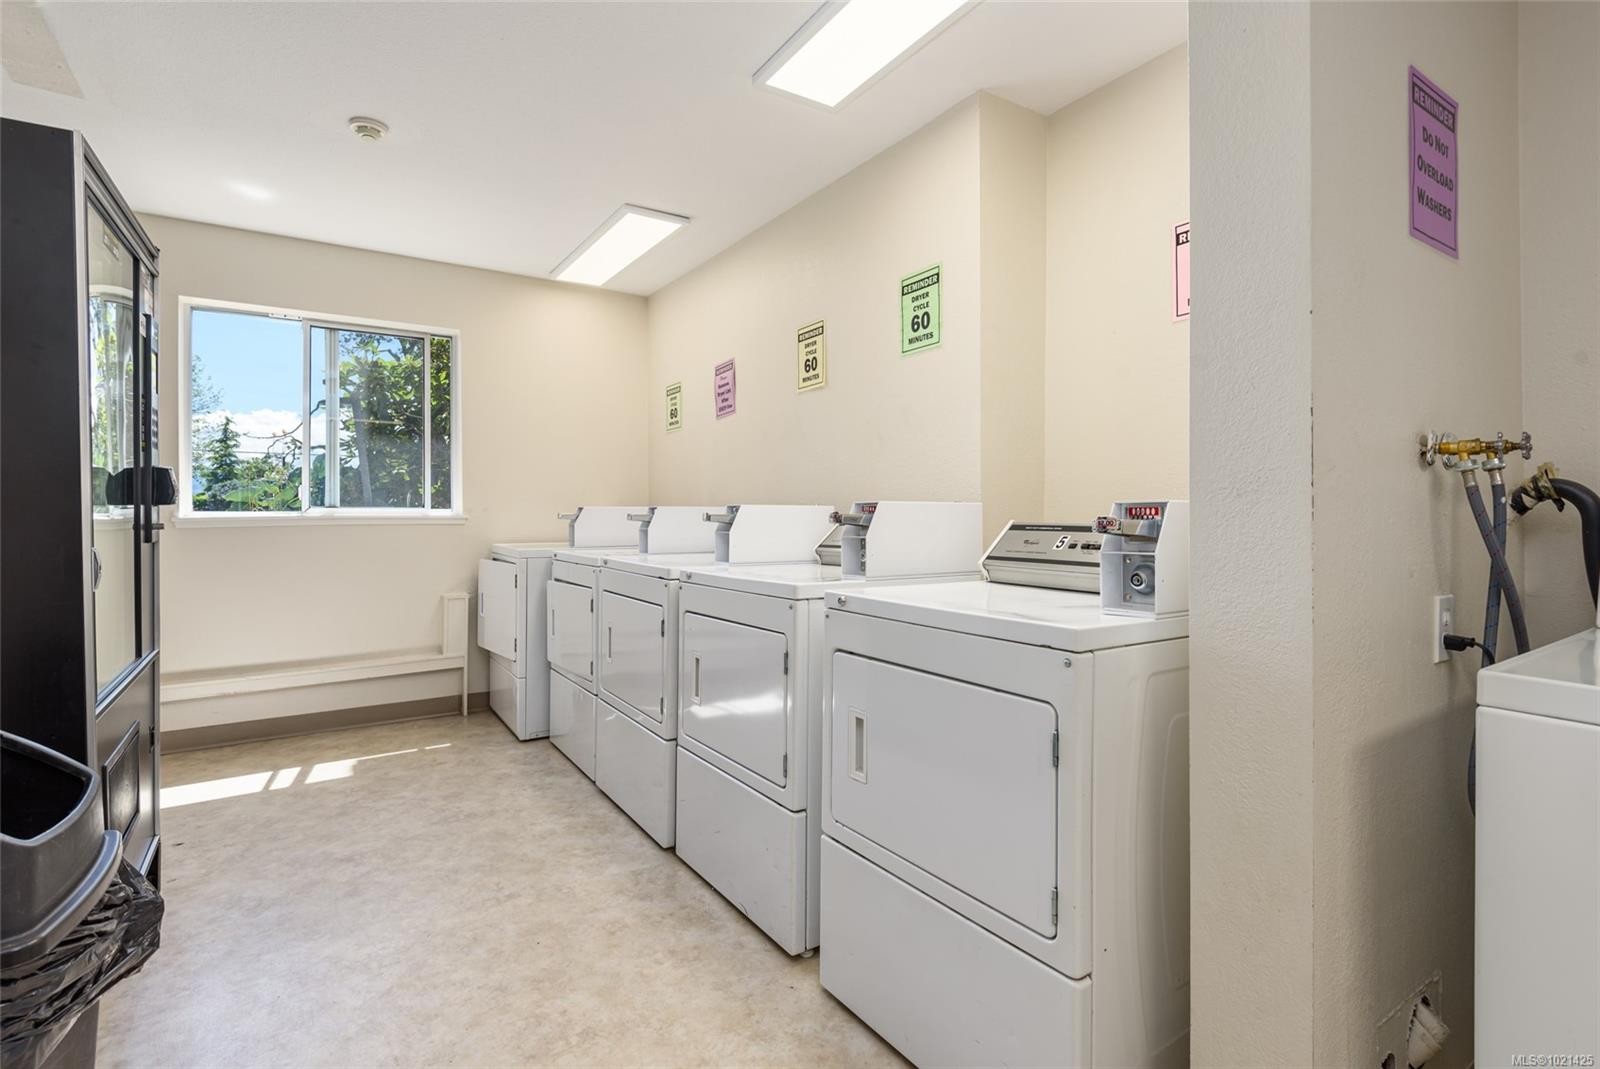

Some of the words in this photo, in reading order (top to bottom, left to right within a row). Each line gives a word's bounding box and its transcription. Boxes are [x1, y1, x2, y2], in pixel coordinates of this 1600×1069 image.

[1414, 84, 1454, 131] REMINDER
[1422, 125, 1434, 147] DO
[1434, 135, 1449, 159] NOT
[1417, 154, 1454, 192] OVERLOAD
[1417, 186, 1452, 221] WASHERS
[903, 274, 938, 294] REMINDER
[911, 291, 930, 303] DRYER
[912, 301, 930, 312] CYCLE
[911, 311, 930, 333] 60
[908, 331, 934, 345] MINUTES
[804, 356, 817, 373] 60
[670, 407, 678, 420] 60
[1055, 536, 1068, 549] 5
